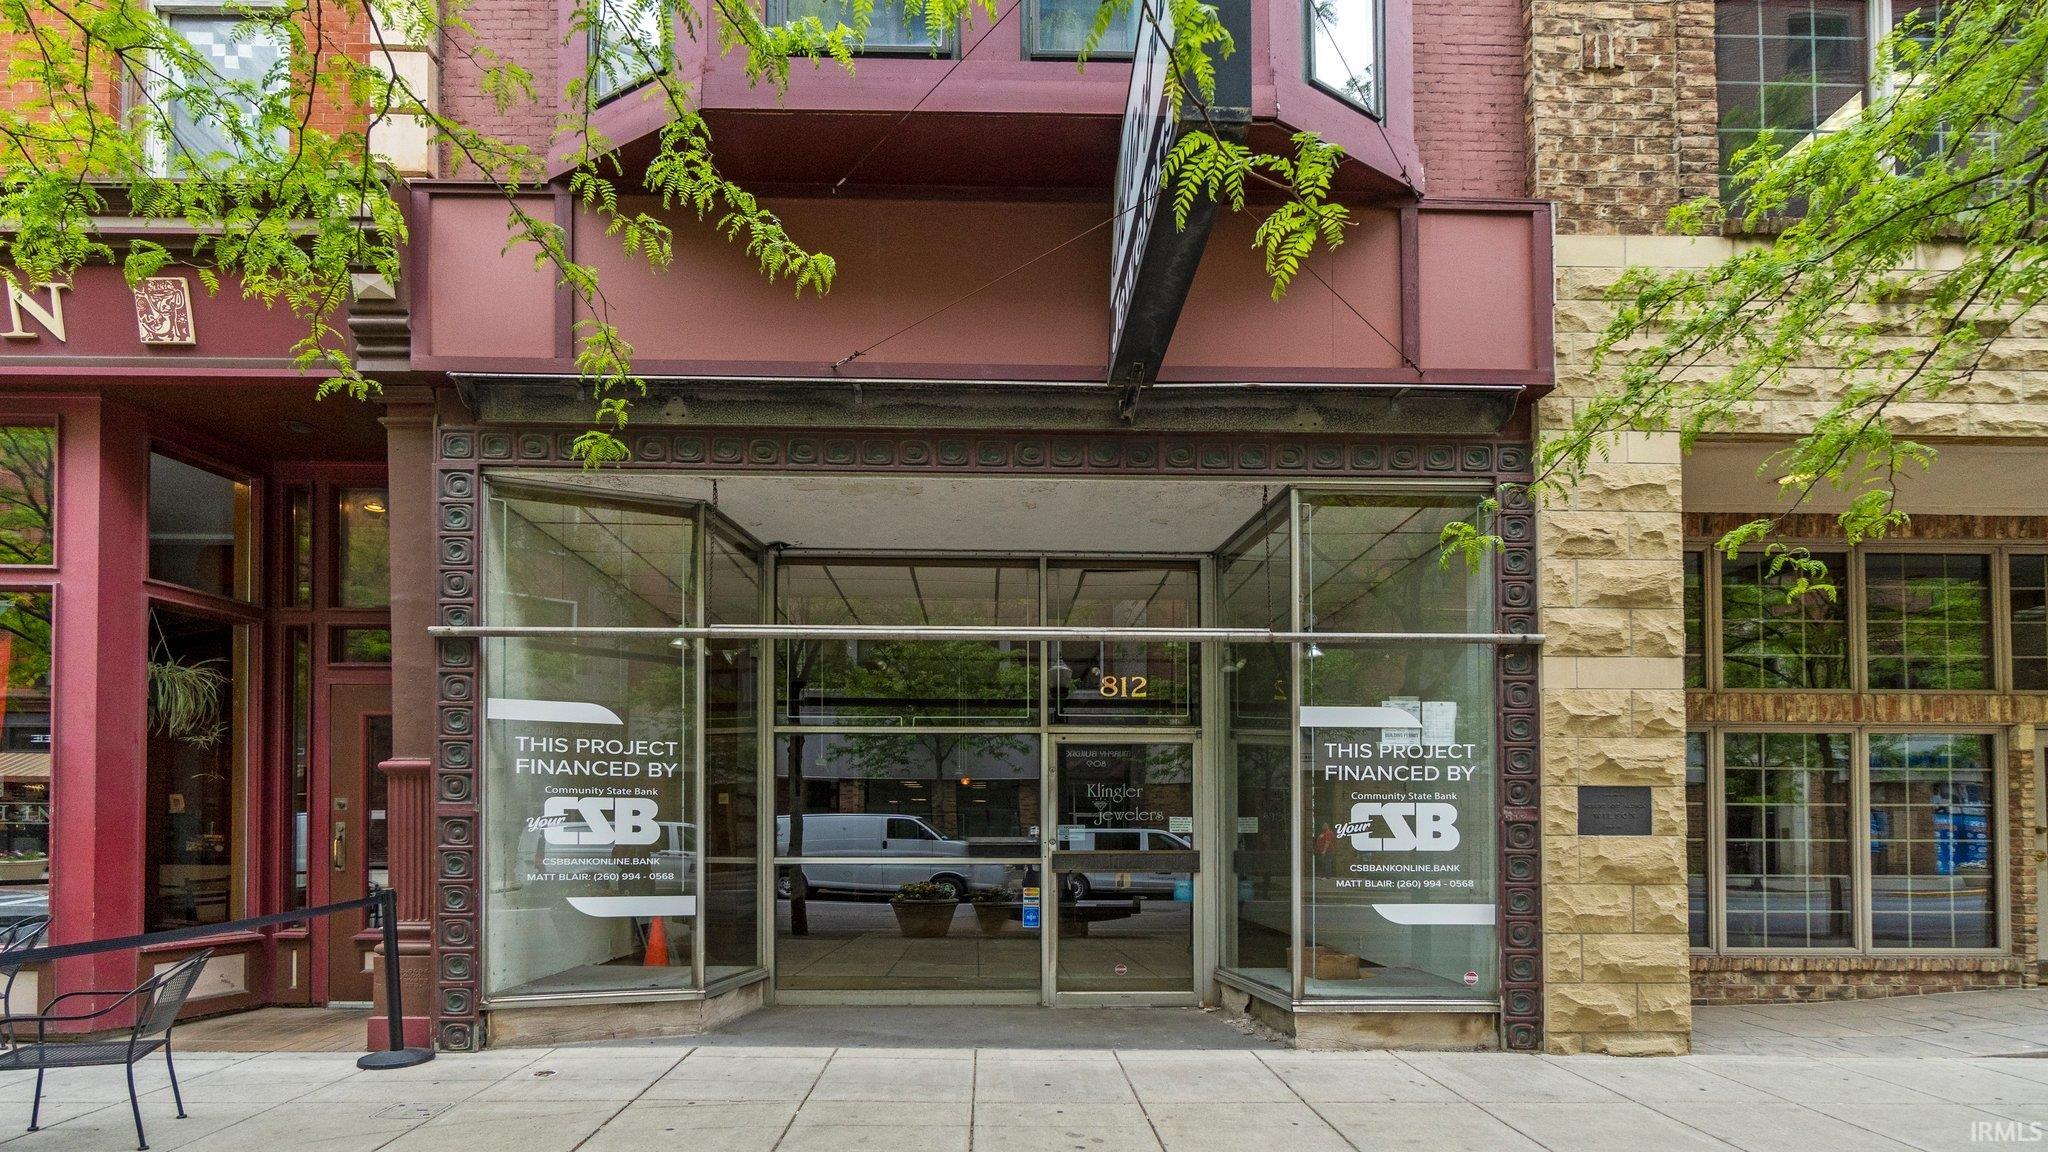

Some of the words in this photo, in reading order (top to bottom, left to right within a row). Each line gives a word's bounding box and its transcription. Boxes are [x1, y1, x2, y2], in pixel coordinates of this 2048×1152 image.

[1100, 675, 1148, 698] 812
[515, 736, 569, 753] THIS
[576, 738, 678, 756] PROJECT
[1324, 743, 1373, 759] THIS
[1379, 743, 1476, 759] PROJECT
[515, 758, 641, 777] FINANCED
[648, 762, 678, 778] BY
[1325, 765, 1440, 781] FINANCED
[1447, 765, 1476, 781] BY
[544, 785, 605, 796] Community
[606, 786, 632, 795] State
[634, 787, 659, 796] Bank
[1086, 782, 1143, 803] Klingler
[1351, 791, 1406, 801] Community
[1408, 792, 1432, 800] State
[1434, 792, 1458, 800] Bank
[526, 814, 568, 832] Your
[1335, 820, 1372, 838] Your
[542, 857, 661, 866] CSBBANKONLINE.BANK
[1349, 864, 1461, 872] CSBBANKONLINE.BANK
[526, 873, 557, 881] MATT
[558, 872, 591, 881] BLAIR:
[593, 872, 620, 882] (260)
[621, 872, 641, 880] 994
[649, 872, 675, 880] 0568
[1335, 879, 1363, 888] MATT
[1364, 879, 1395, 888] BLAIR:
[1396, 879, 1421, 889] (260)
[1423, 879, 1442, 888] 994
[1449, 879, 1474, 888] 0568
